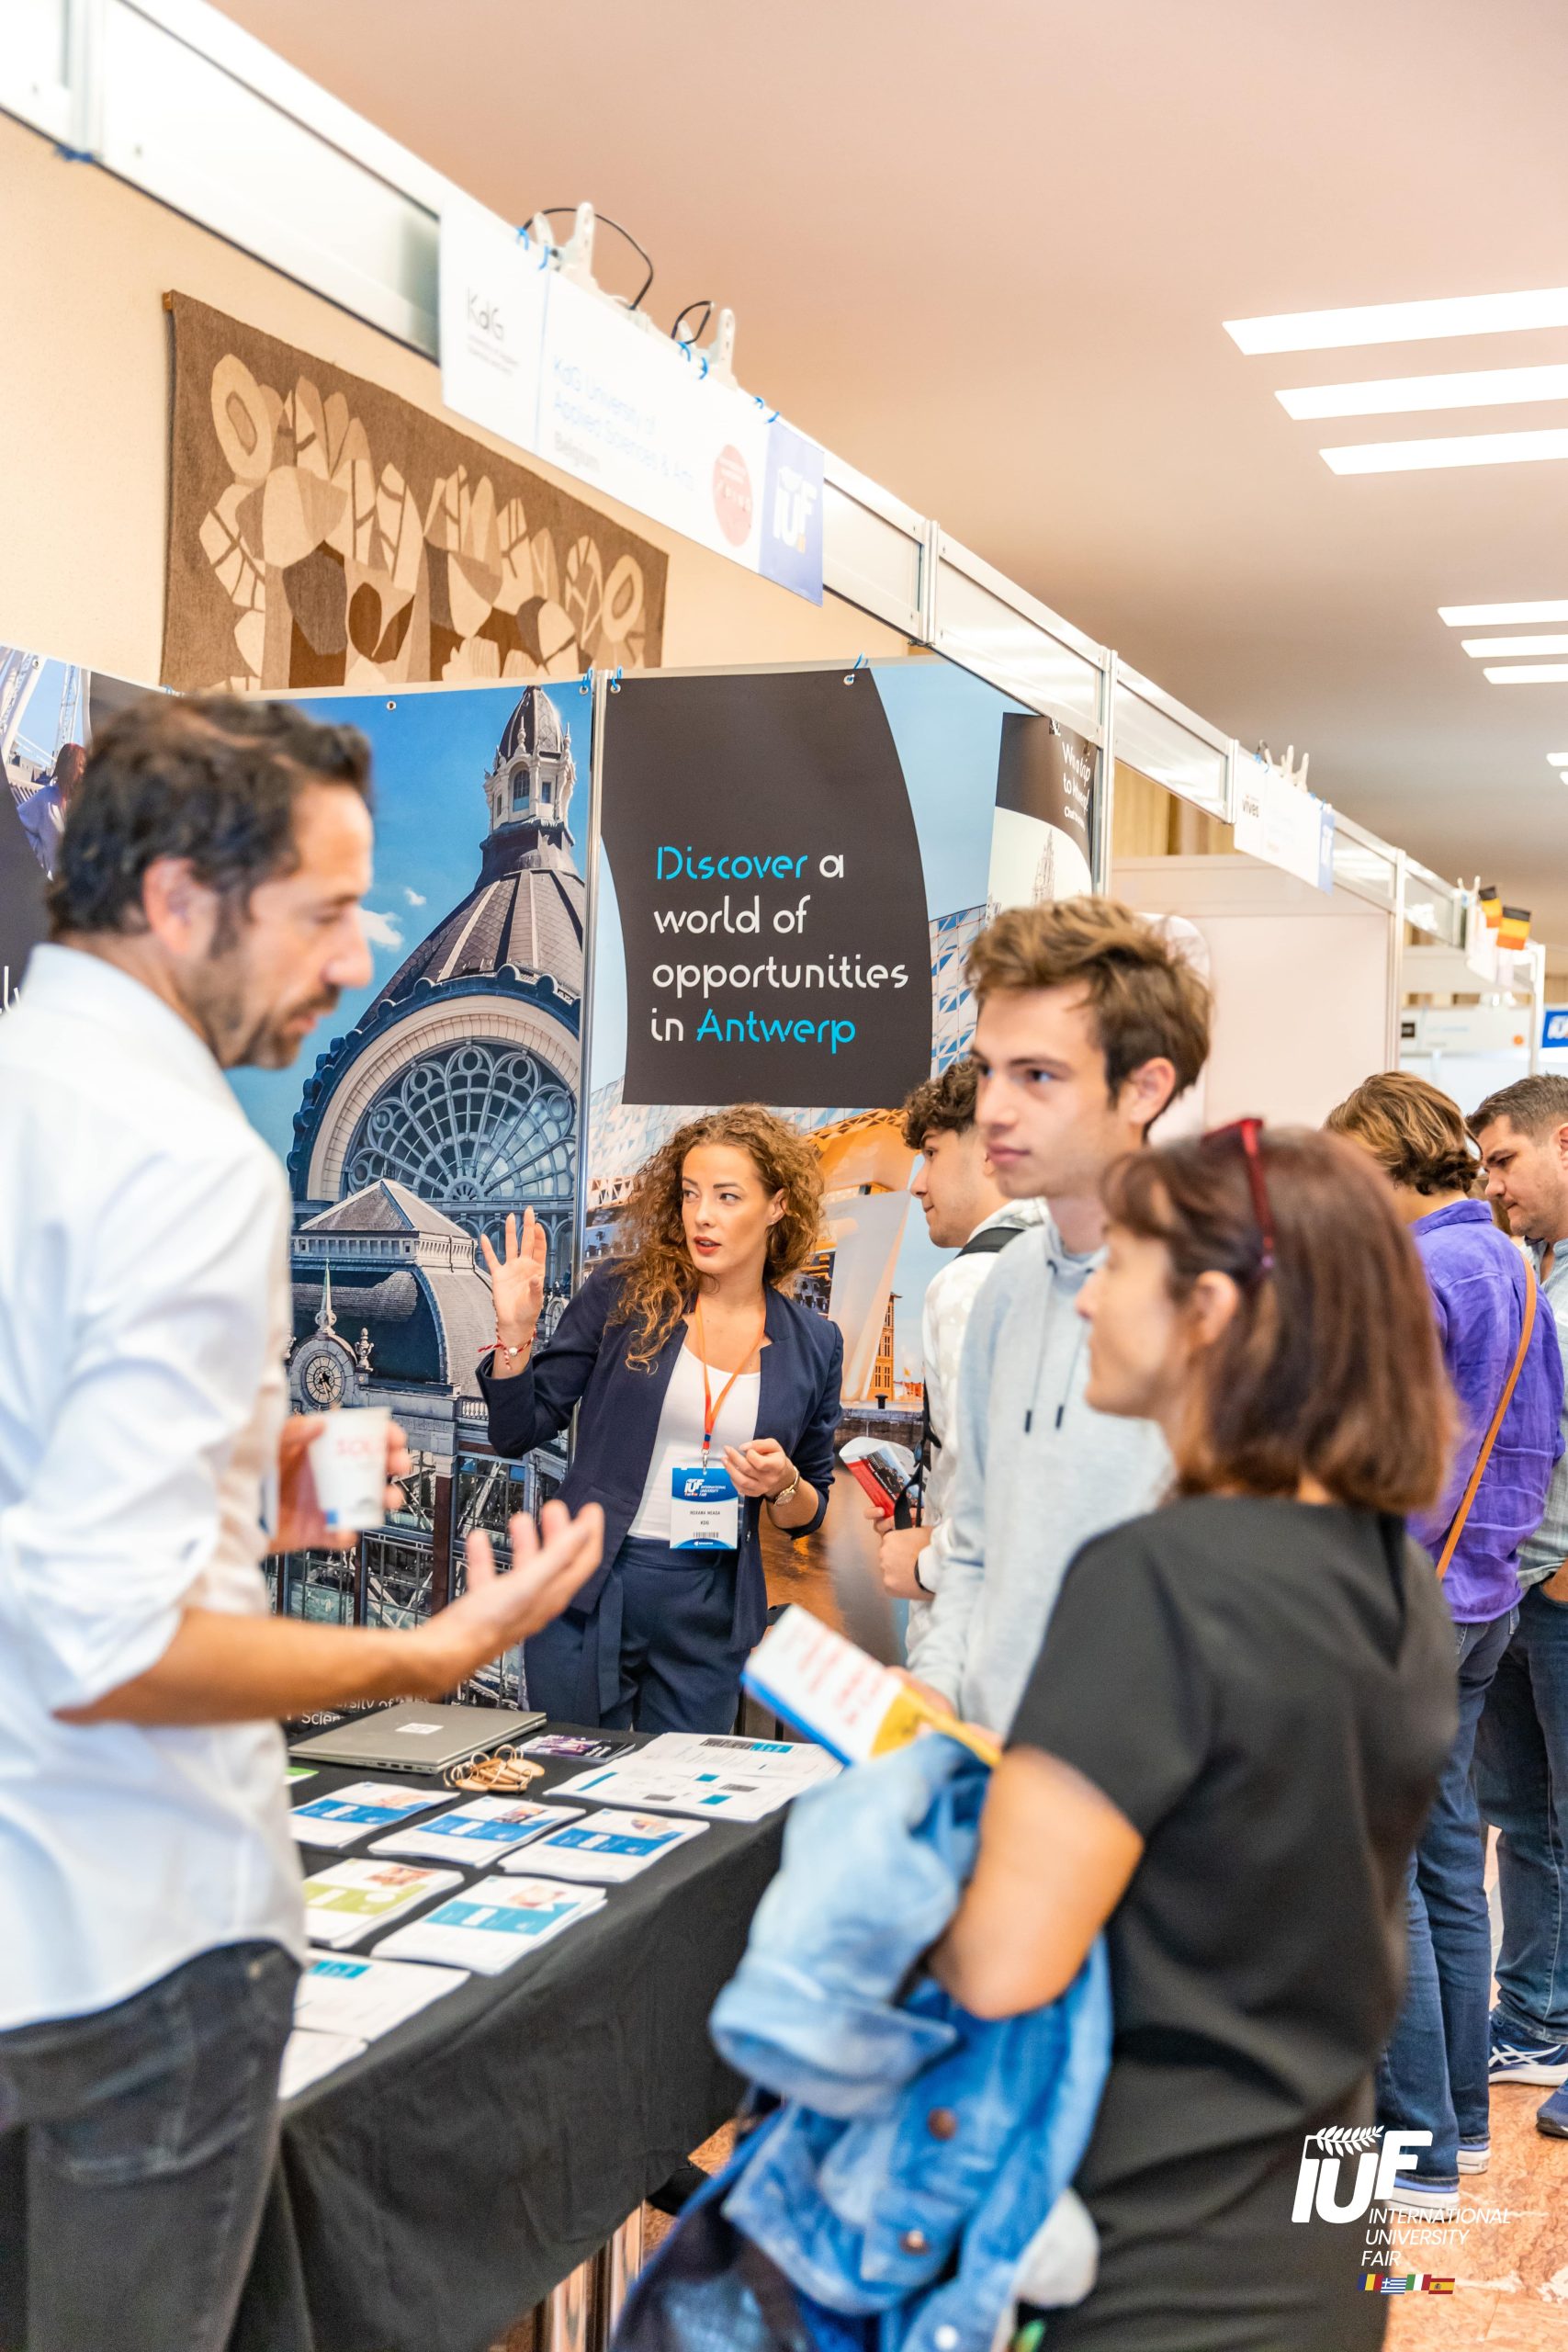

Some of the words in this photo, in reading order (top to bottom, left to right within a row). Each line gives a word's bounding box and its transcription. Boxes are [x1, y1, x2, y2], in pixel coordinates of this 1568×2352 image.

[657, 846, 808, 879] Discover
[819, 854, 844, 878] a
[653, 895, 761, 933] world
[773, 895, 811, 933] of
[652, 954, 909, 999] opportunities
[651, 1008, 683, 1042] in
[696, 1008, 856, 1054] Antwerp
